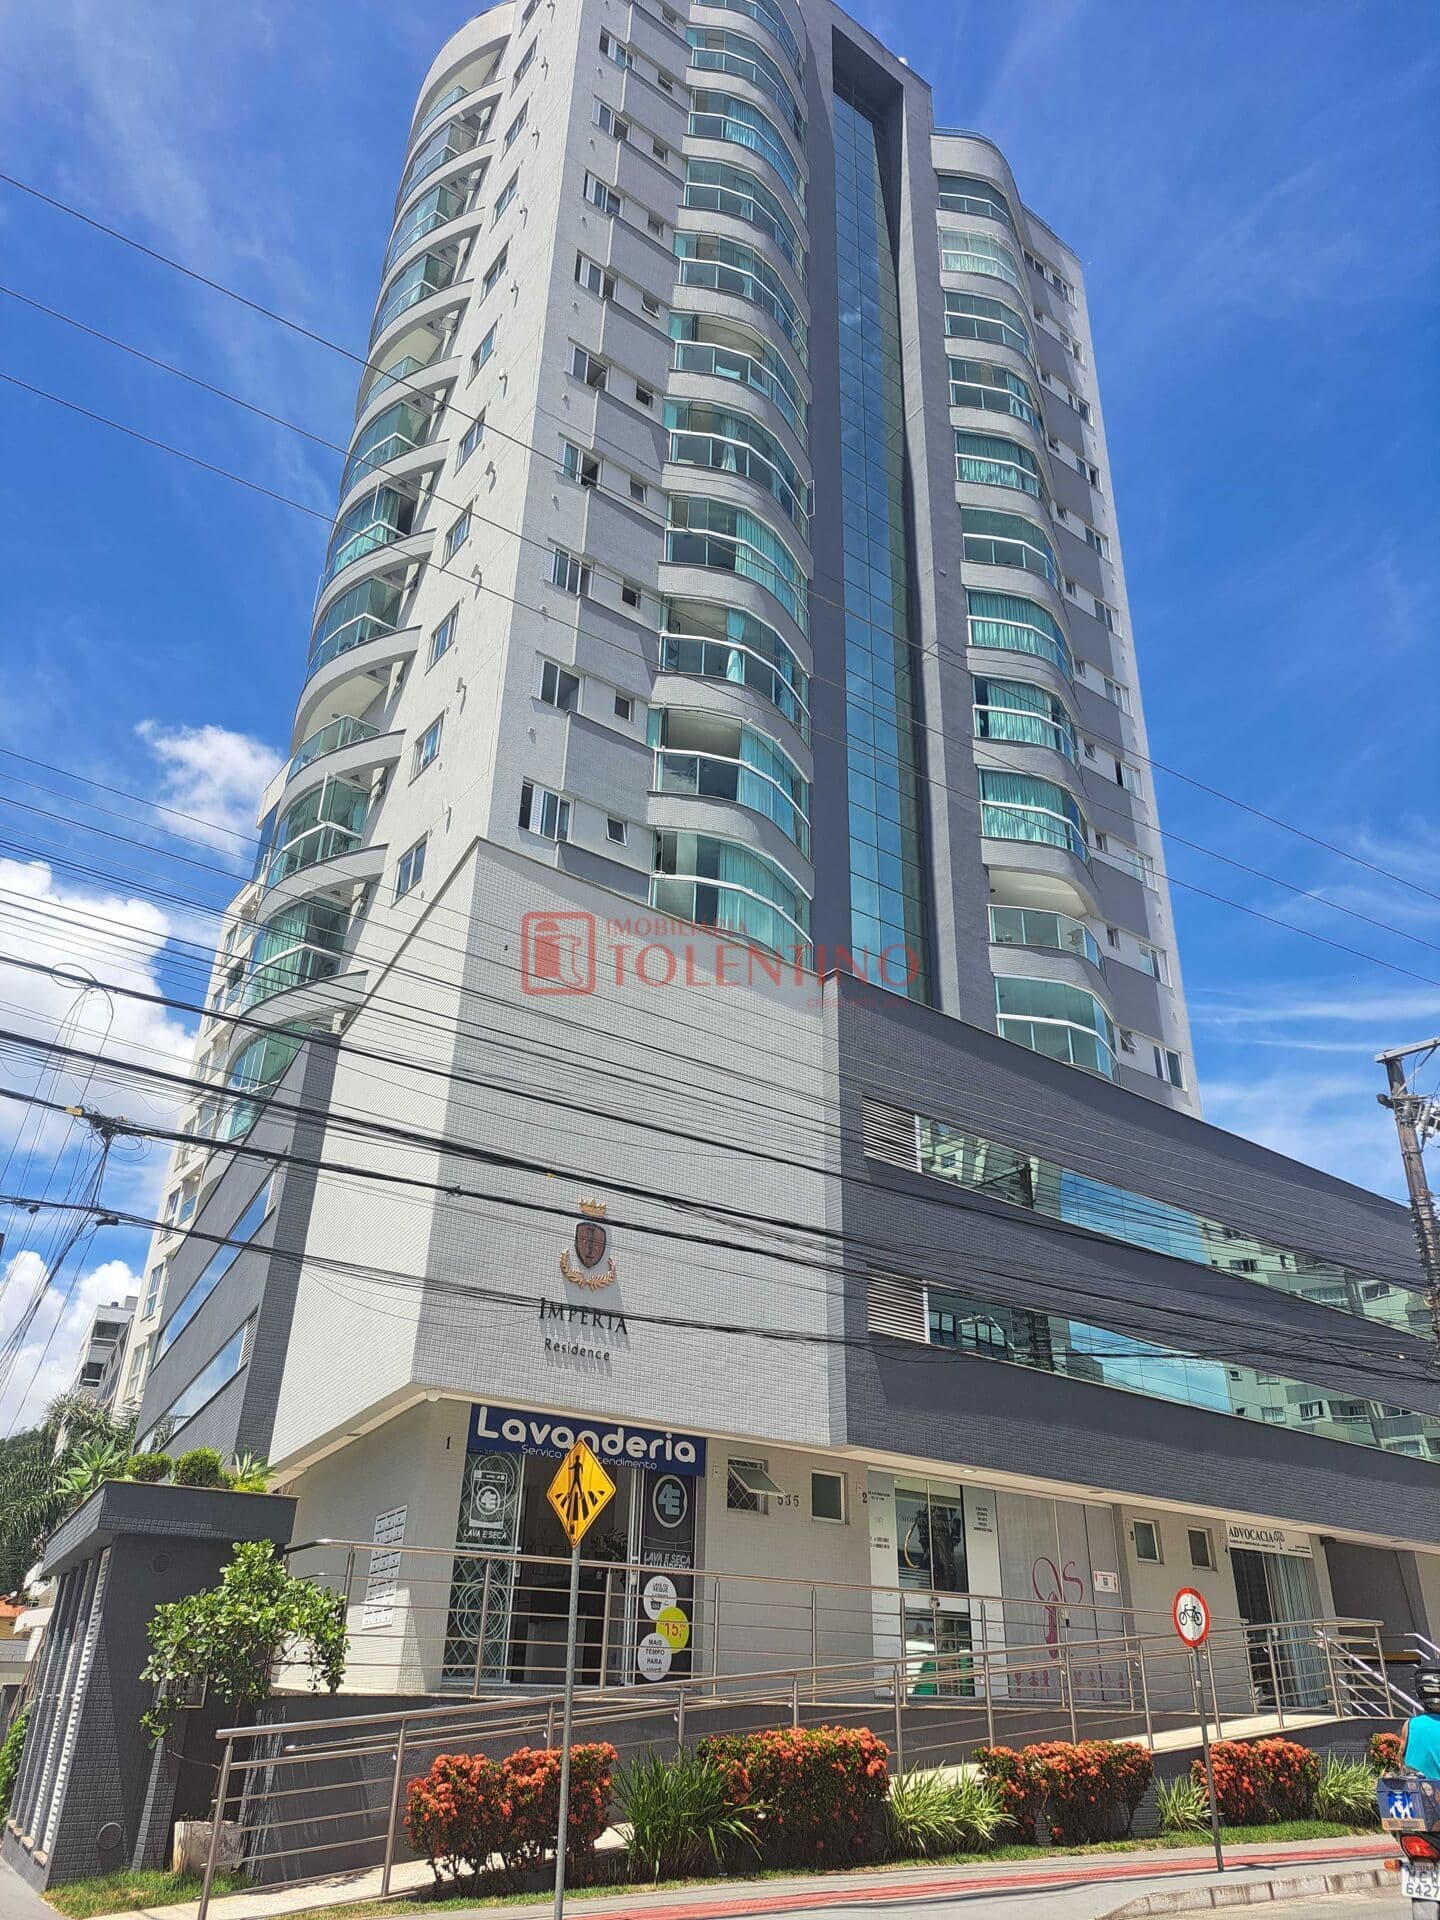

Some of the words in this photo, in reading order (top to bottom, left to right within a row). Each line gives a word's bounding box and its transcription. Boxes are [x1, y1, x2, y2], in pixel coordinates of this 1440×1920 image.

[540, 1297, 628, 1335] IMPERIA
[544, 1338, 610, 1361] Residence
[477, 1406, 696, 1463] Lavanderia
[446, 1436, 451, 1450] 1
[862, 1492, 868, 1503] 2
[464, 1528, 480, 1538] LAVA
[489, 1530, 507, 1540] SECA
[1229, 1526, 1275, 1543] ADVOCACIA
[643, 1551, 663, 1563] LAVA
[670, 1553, 691, 1565] SECA
[646, 1648, 665, 1656] TEMPO
[1406, 1882, 1440, 1898] 6427
